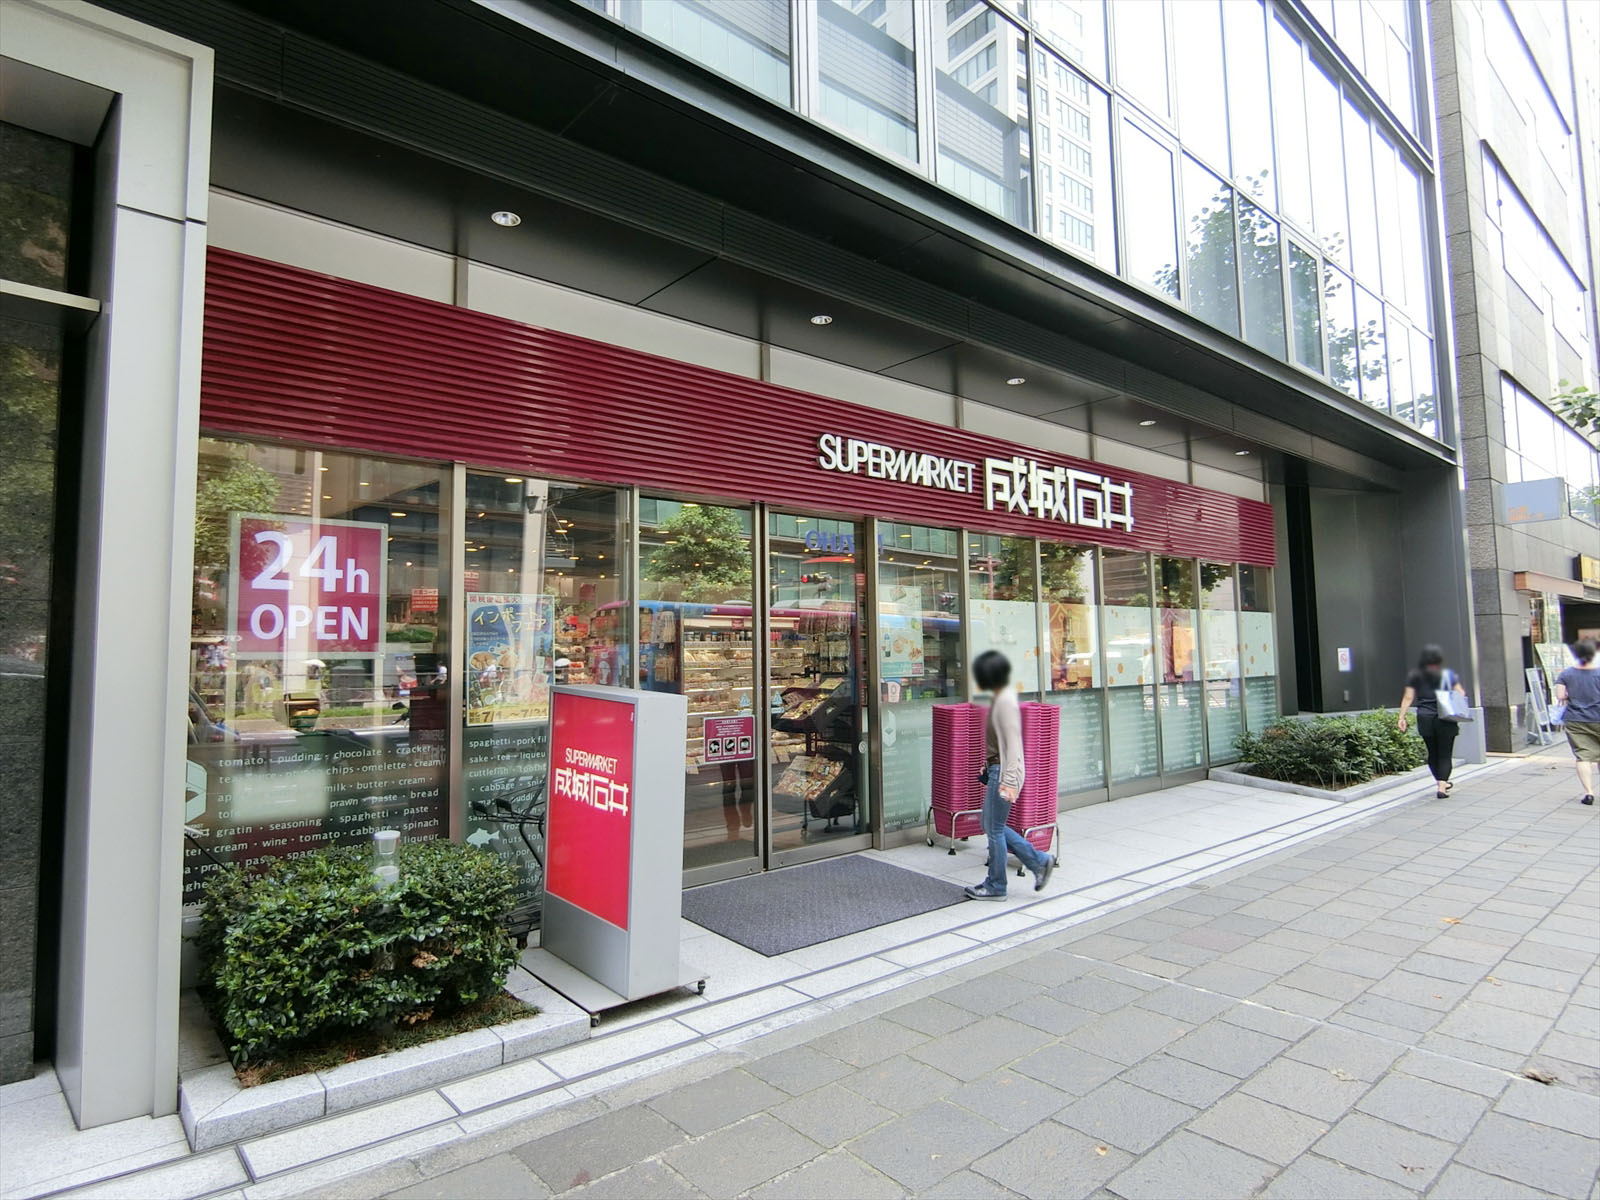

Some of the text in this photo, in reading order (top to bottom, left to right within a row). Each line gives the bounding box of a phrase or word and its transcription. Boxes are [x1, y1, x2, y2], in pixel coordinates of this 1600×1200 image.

[818, 433, 975, 493] SUPERMARKET
[984, 456, 1134, 532] 成城石井
[251, 530, 370, 593] 24h
[250, 603, 369, 640] OPEN
[474, 607, 538, 626] インポート
[512, 618, 547, 633] フェア
[469, 735, 547, 749] spaghetti pork fil
[219, 744, 432, 767] tomato pudding chocolate cracker
[469, 754, 489, 764] sake
[520, 751, 546, 760] liqueu
[565, 747, 618, 775] SUPERMARKET
[326, 759, 441, 776] chips omelette cream
[469, 766, 509, 778] cuttlefish
[323, 776, 426, 793] milk butter cream
[480, 781, 515, 792] cabbage
[555, 767, 629, 817] 成城石井
[330, 788, 439, 809] prawn paste bread
[216, 826, 252, 838] gratin
[269, 818, 322, 831] seasoning
[340, 809, 389, 823] spaghetti
[403, 805, 429, 816] paste
[214, 842, 248, 853] cream
[262, 837, 288, 848] wine
[299, 831, 341, 843] tomato
[350, 825, 392, 836] cabbage
[403, 818, 439, 830] spinach
